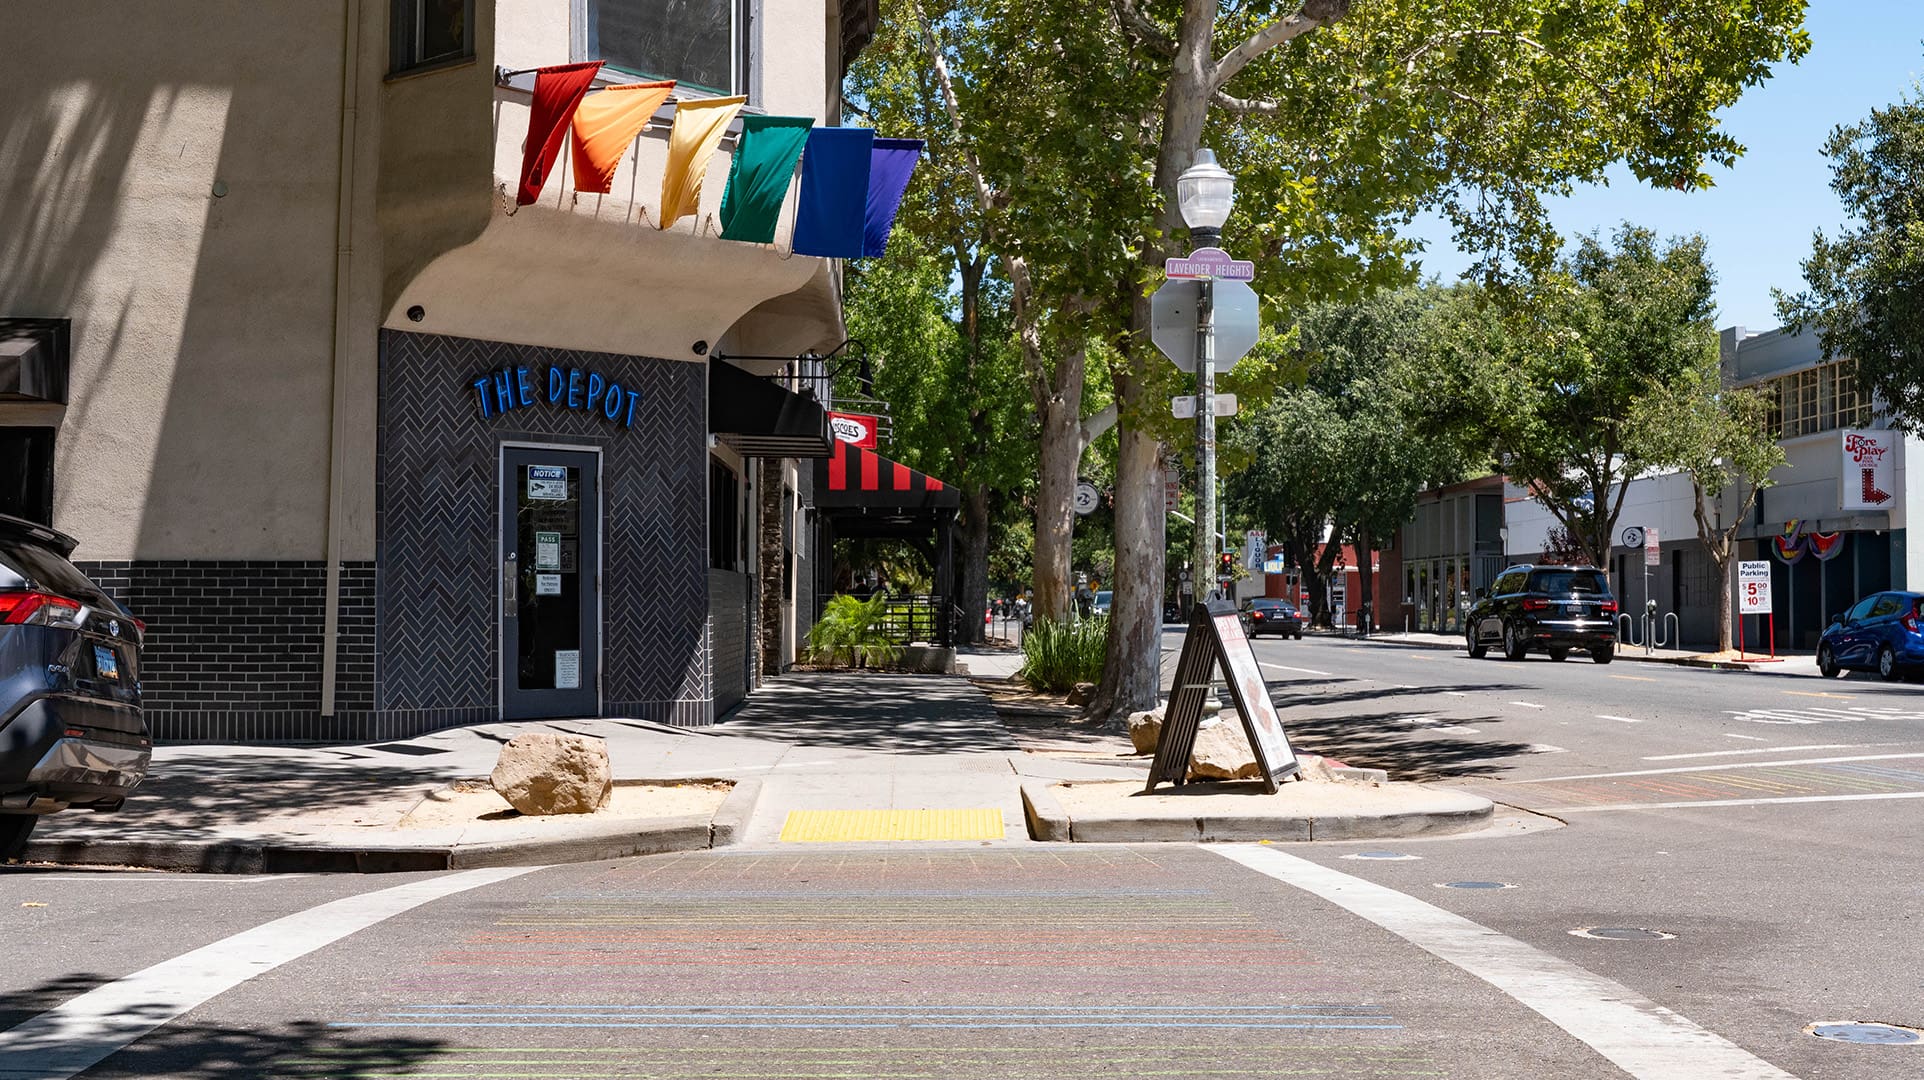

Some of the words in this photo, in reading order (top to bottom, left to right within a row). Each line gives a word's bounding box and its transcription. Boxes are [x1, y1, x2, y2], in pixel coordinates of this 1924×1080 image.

[1169, 263, 1211, 275] LAVENDER
[1215, 264, 1252, 277] HEIGHTS
[474, 365, 533, 419] THE
[549, 366, 641, 429] DEPOT
[1845, 434, 1877, 452] Fore
[1853, 446, 1889, 462] Play
[533, 470, 561, 478] NOTICE
